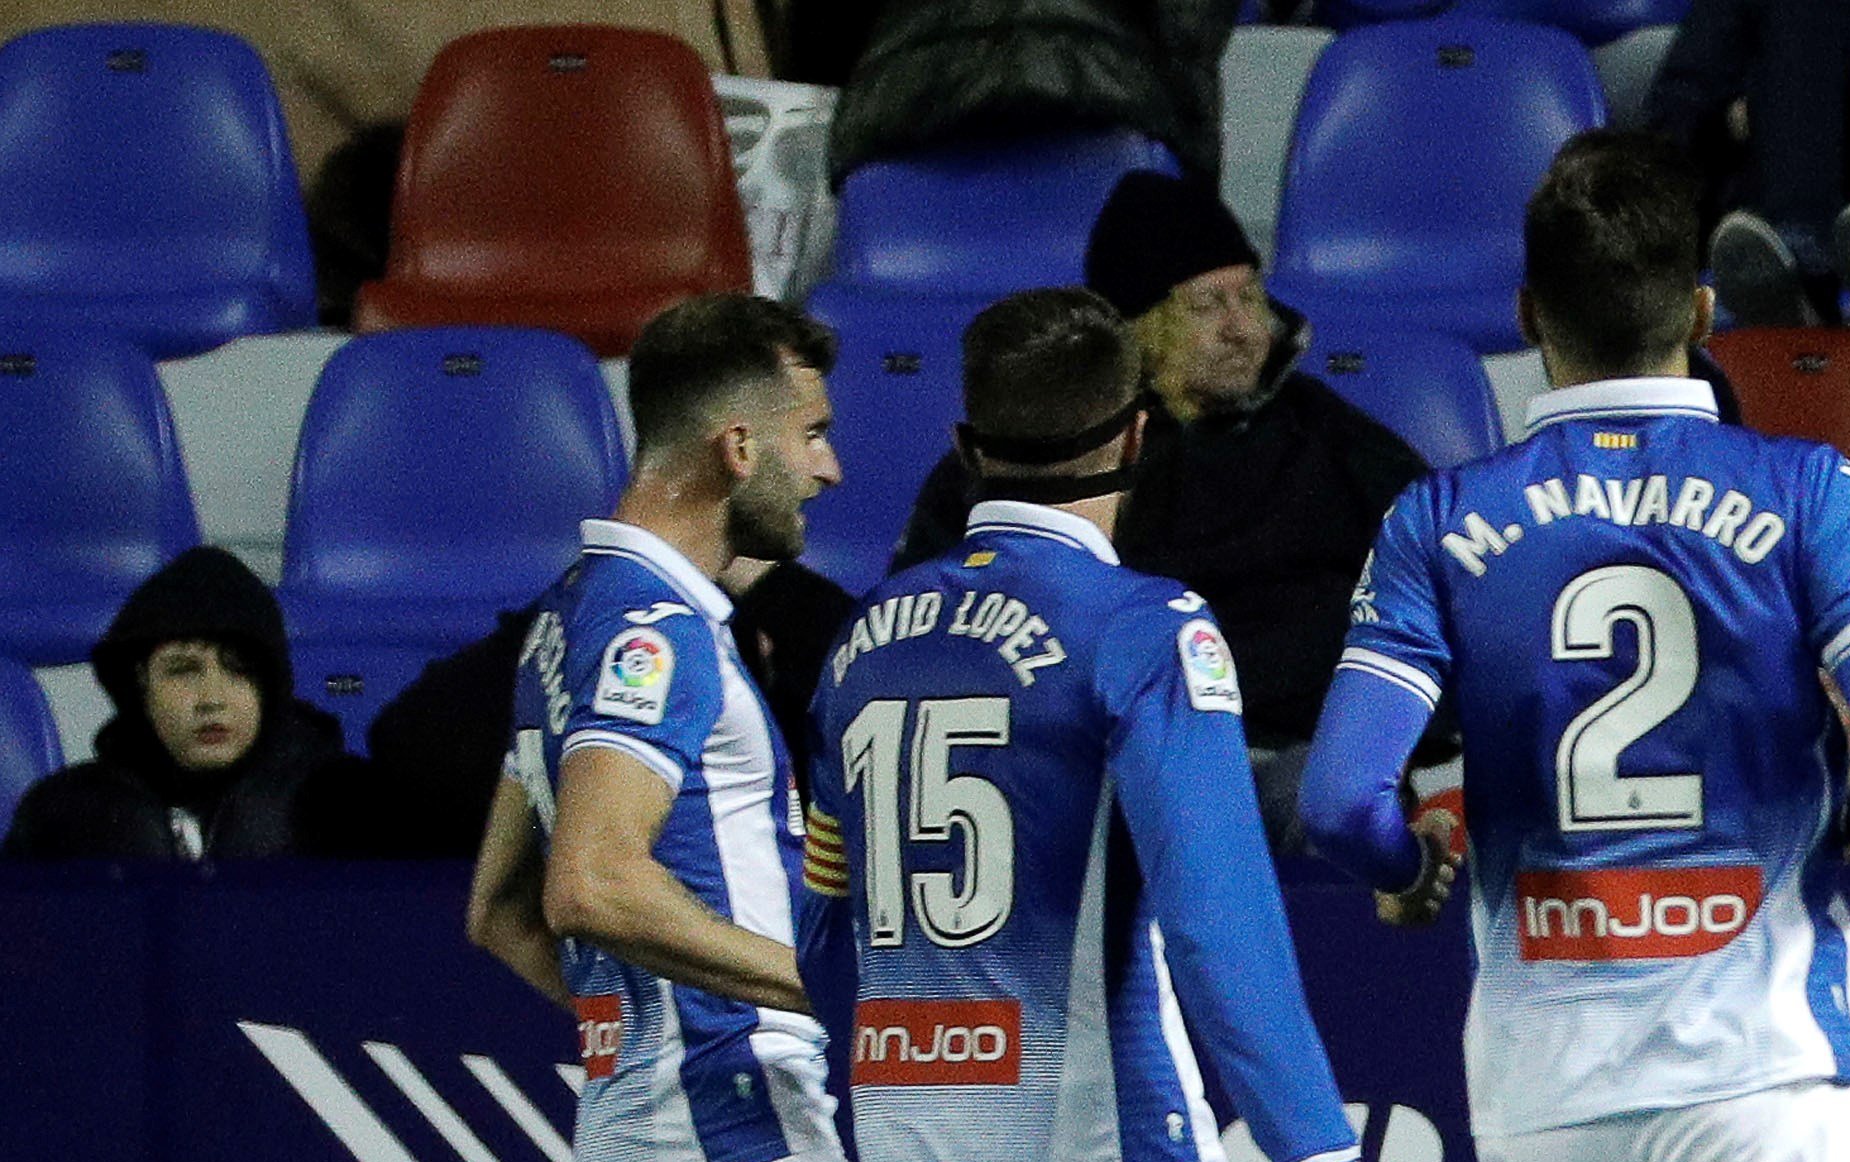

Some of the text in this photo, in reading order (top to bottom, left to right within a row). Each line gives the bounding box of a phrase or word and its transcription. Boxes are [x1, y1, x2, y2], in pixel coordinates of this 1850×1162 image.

[1441, 473, 1787, 578] M. NAVARRO
[832, 591, 1068, 688] DAVID LOPEZ
[1550, 565, 1703, 832] 2
[841, 696, 1015, 948] 15
